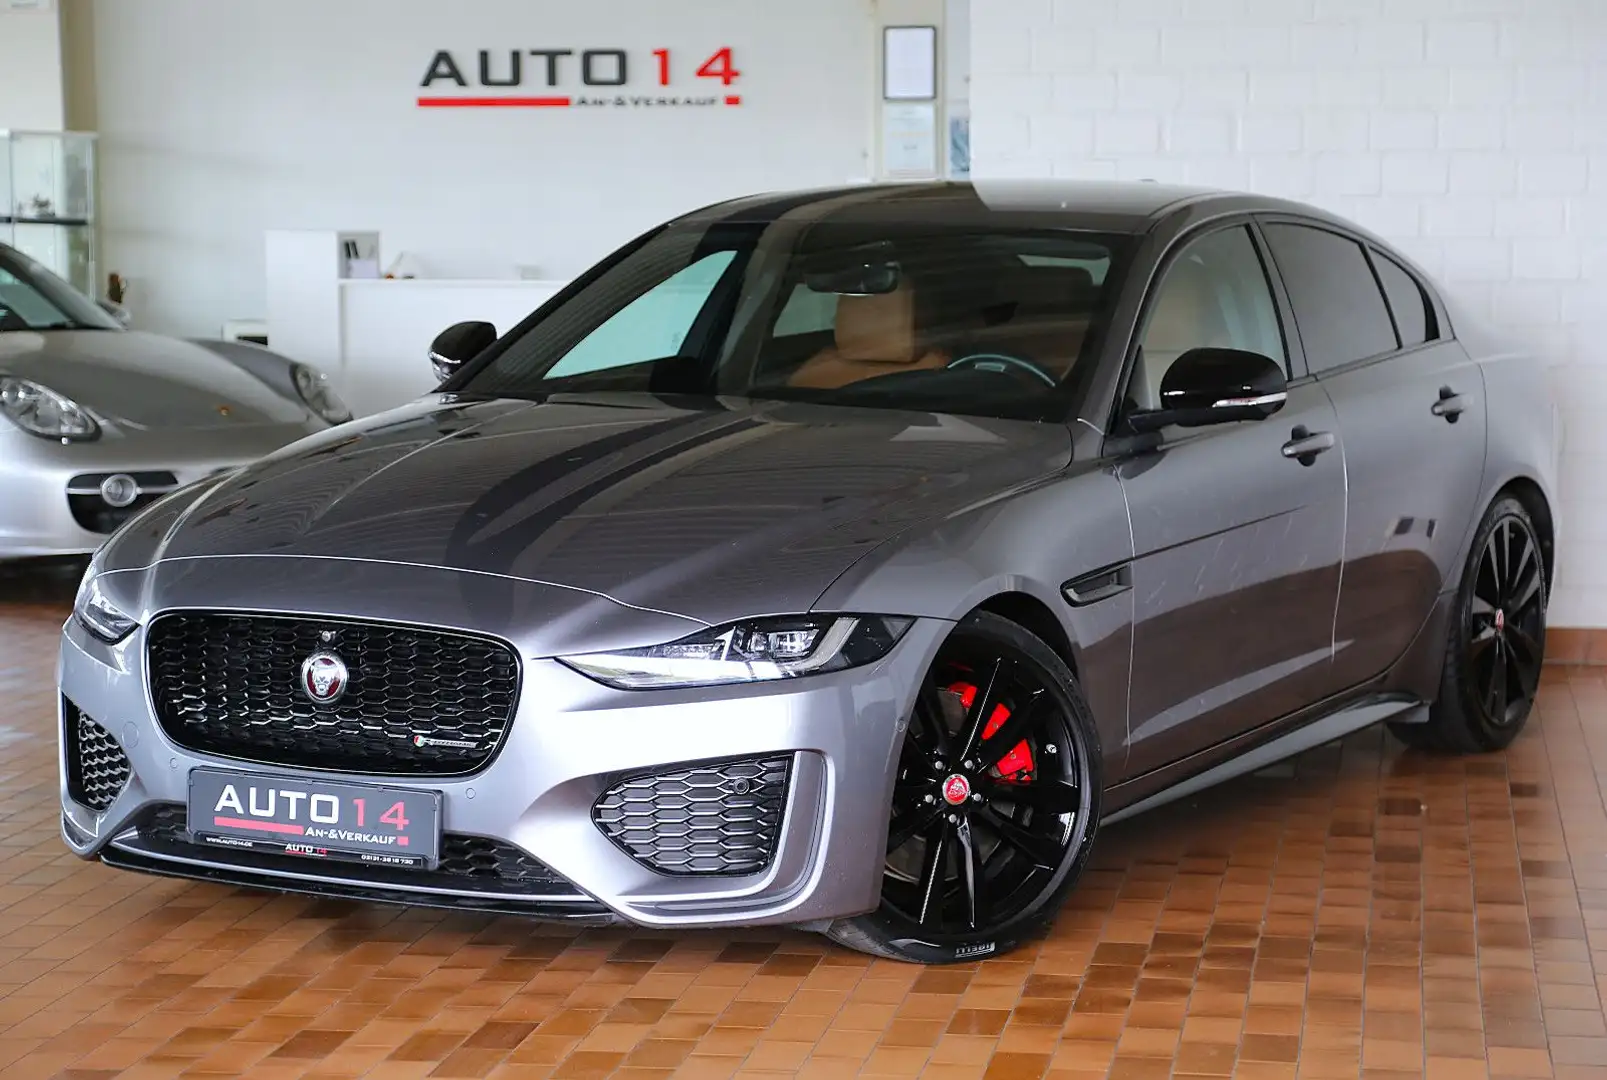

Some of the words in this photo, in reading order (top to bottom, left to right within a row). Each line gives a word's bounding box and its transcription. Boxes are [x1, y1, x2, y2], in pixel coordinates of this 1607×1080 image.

[419, 49, 627, 87] AUTO
[650, 47, 741, 86] 14
[213, 784, 340, 825] AUTO
[352, 798, 410, 831] 14
[285, 842, 314, 853] AUTO
